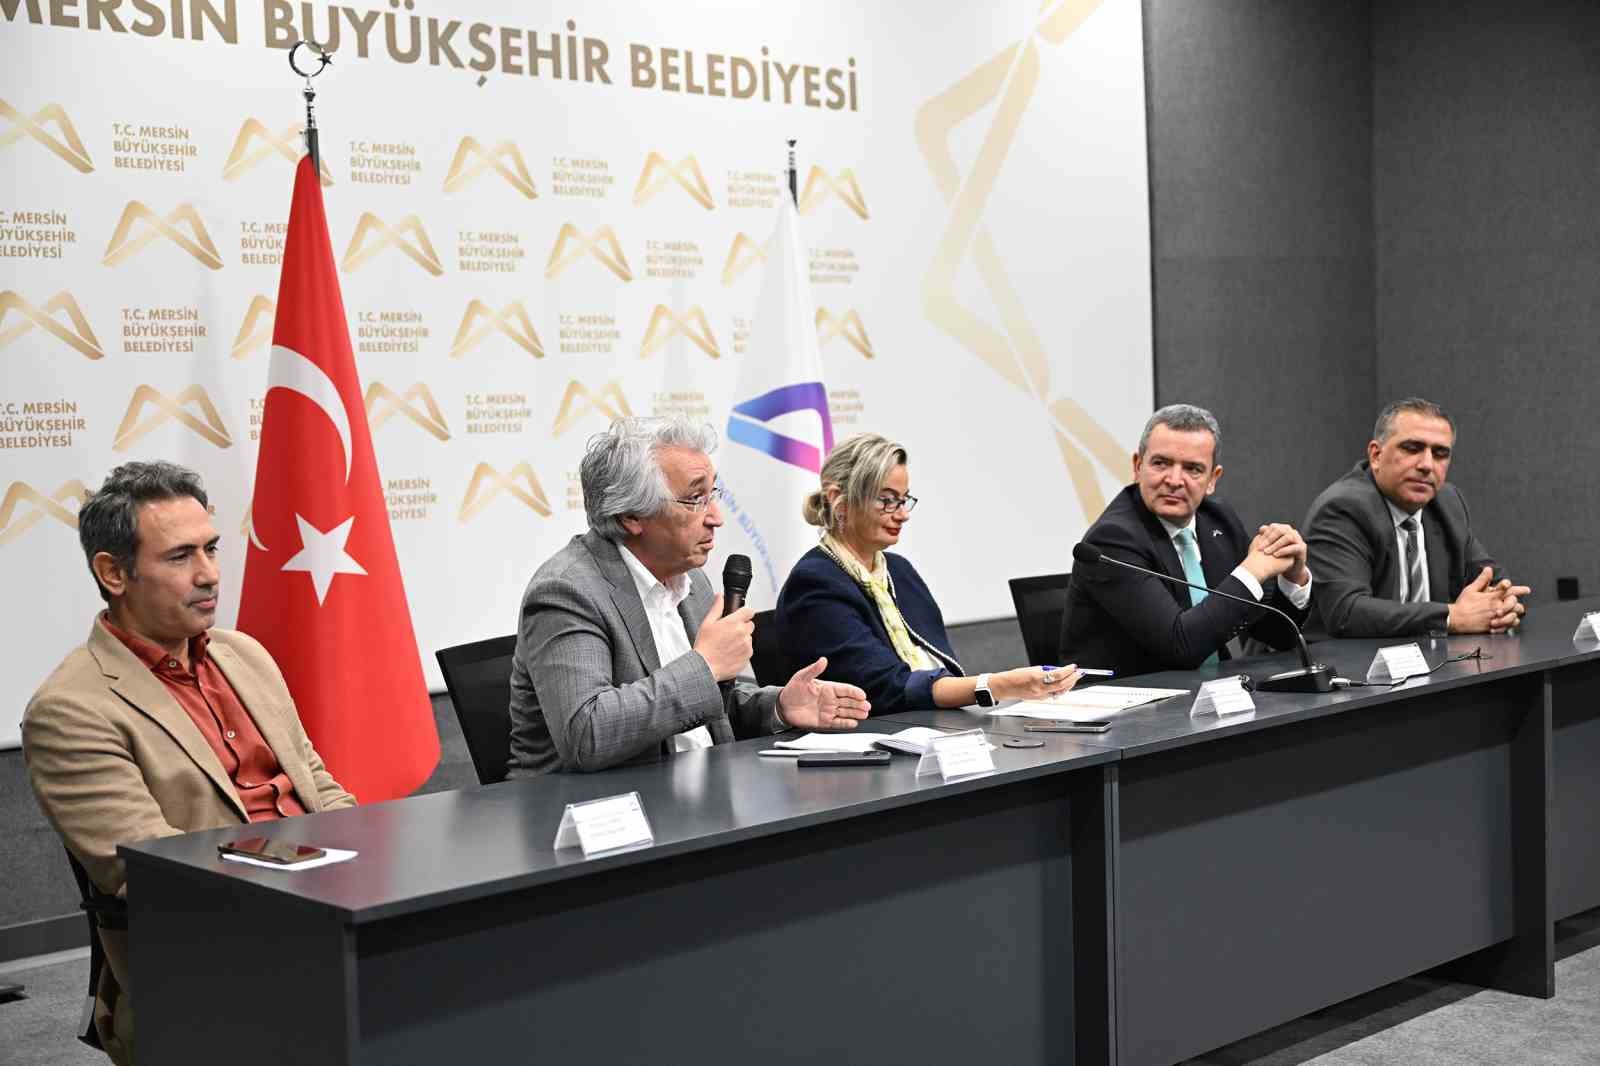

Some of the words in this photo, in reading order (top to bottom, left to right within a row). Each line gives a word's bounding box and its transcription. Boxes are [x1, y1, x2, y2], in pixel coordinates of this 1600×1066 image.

[263, 0, 613, 87] BÜYÜKŞEHİR
[629, 44, 859, 112] BELEDİYESİ
[113, 124, 136, 137] T.C.
[140, 125, 190, 139] MERSİN
[350, 141, 368, 154] T.C.
[372, 143, 416, 156] MERSİN
[114, 156, 185, 172] BELEDİYESİ
[351, 171, 411, 185] BELEDİYESİ
[13, 210, 67, 225] MERSİN
[0, 225, 76, 244] YÜKŞEHİR
[240, 222, 260, 235] T.C.
[240, 235, 284, 252] BÜYÜK
[0, 243, 63, 260] ELEDİYESİ
[241, 252, 282, 266] BELEDİ
[123, 308, 145, 321] T.C.
[148, 307, 198, 321] MERSİN
[358, 311, 376, 322] T.C.
[379, 310, 422, 322] MERSİN
[124, 338, 193, 353] BELEDİYESİ
[358, 338, 418, 353] BELEDİYESİ
[23, 398, 77, 414] MERSİN
[388, 477, 430, 490] MERSİN
